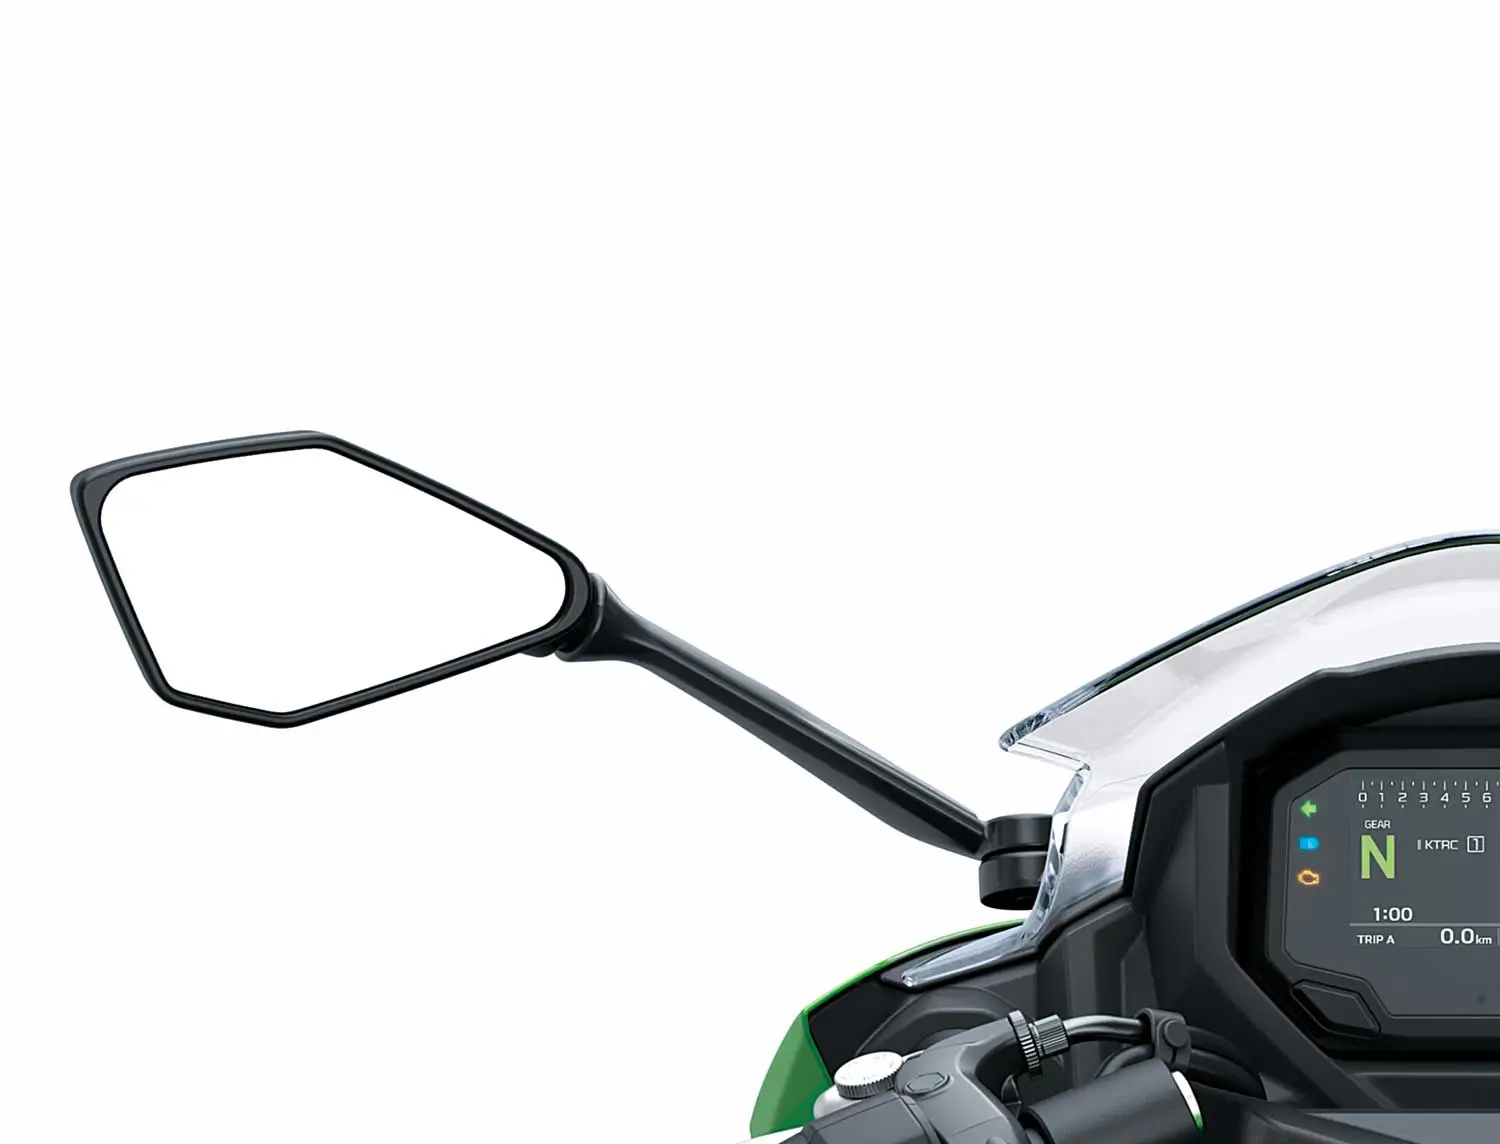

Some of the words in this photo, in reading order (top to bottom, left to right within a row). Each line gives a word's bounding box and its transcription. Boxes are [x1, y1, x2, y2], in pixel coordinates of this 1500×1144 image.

[1358, 792, 1367, 803] 0
[1378, 792, 1384, 803] 1
[1398, 792, 1407, 803] 2
[1419, 792, 1428, 803] 3
[1440, 792, 1449, 803] 4
[1461, 792, 1471, 803] 5
[1482, 792, 1491, 803] 6
[1364, 820, 1391, 829] GEAR
[1424, 839, 1459, 850] KTRC
[1361, 834, 1395, 879] N
[1373, 907, 1413, 921] 1:00
[1357, 934, 1384, 944] TRIP
[1386, 934, 1395, 944] A
